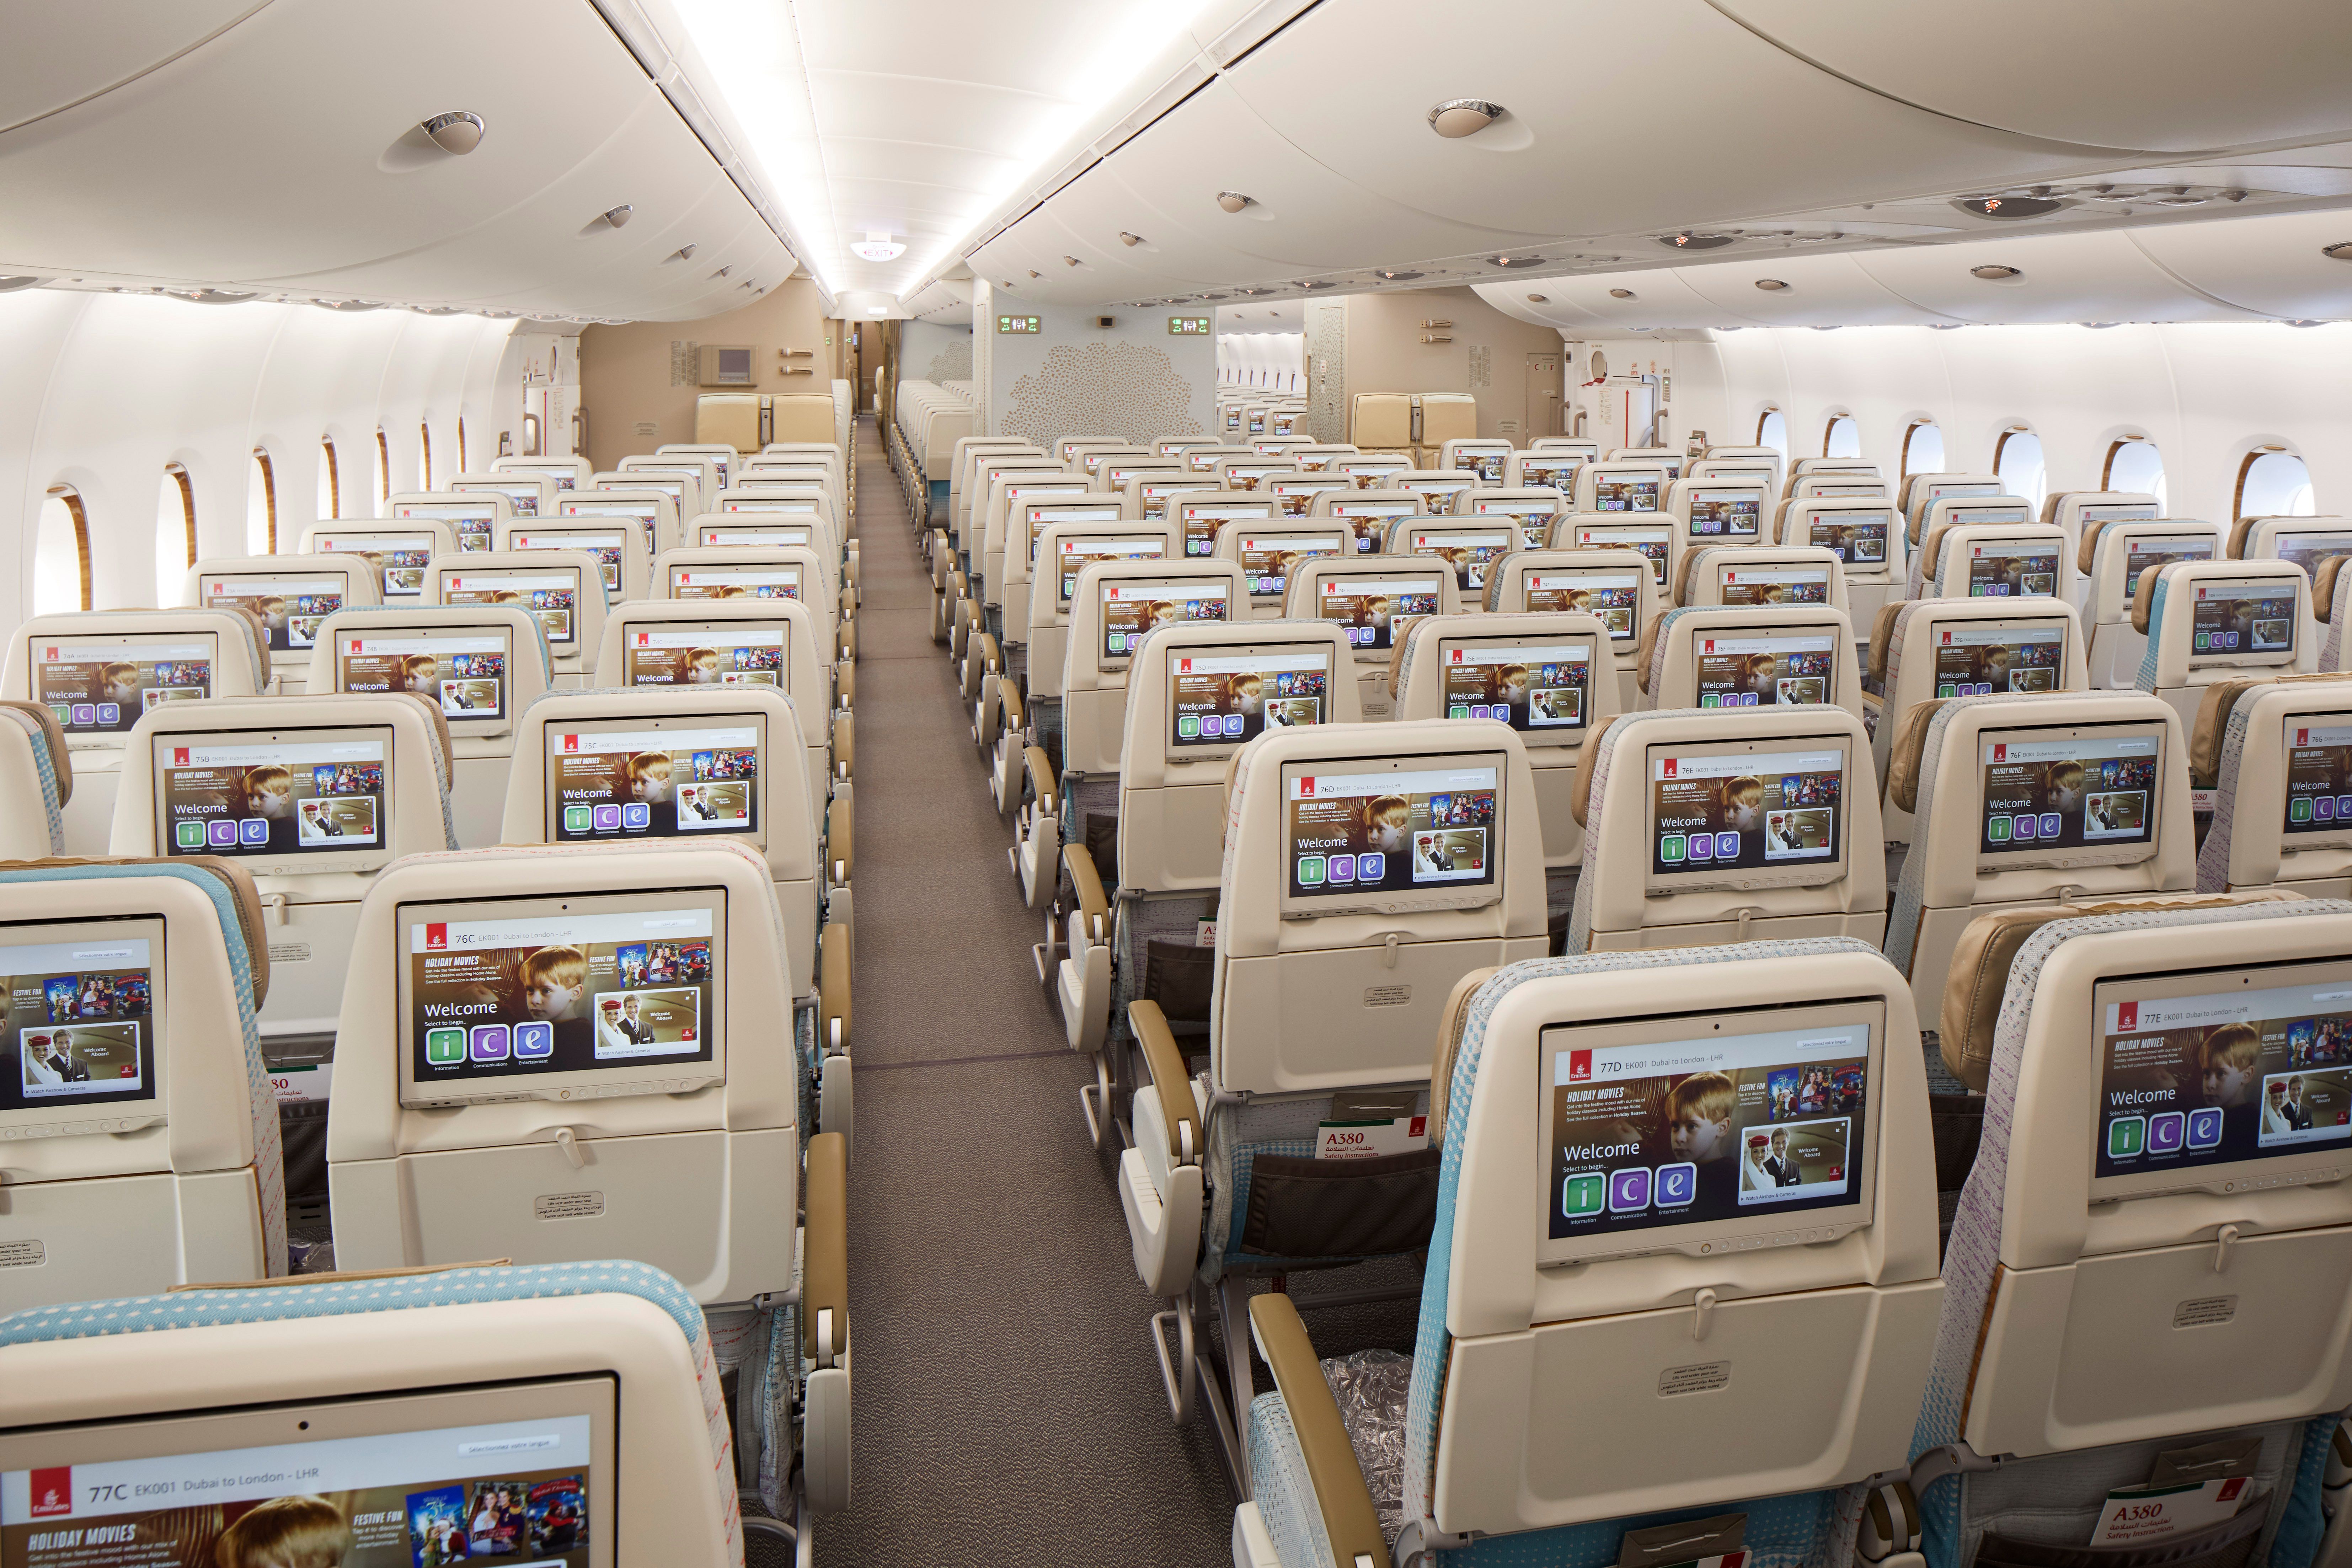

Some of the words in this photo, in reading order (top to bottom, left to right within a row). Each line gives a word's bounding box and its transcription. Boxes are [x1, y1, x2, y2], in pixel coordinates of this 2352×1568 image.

[2292, 781, 2330, 791] Welcome
[563, 789, 612, 798] Welcome
[175, 804, 227, 814] Welcome
[1989, 799, 2031, 809] Welcome
[1661, 817, 1706, 827] Welcome
[1298, 837, 1347, 849] Welcome
[455, 935, 475, 944] 76C
[425, 958, 452, 967] HOLIDAY
[454, 956, 479, 966] MOVIES
[425, 1002, 497, 1017] Welcome
[2144, 1014, 2161, 1024] 77E
[2211, 1008, 2231, 1016] London
[2115, 1039, 2140, 1051] HOLIDAY
[2141, 1037, 2164, 1049] MOVIES
[1600, 1062, 1621, 1073] 77D
[1626, 1061, 1647, 1069] EK001
[1651, 1059, 1669, 1067] Dubai
[1681, 1055, 1704, 1064] London
[272, 1079, 288, 1089] 80
[1739, 1083, 1756, 1091] FESTIVE
[1567, 1090, 1596, 1102] HOLIDAY
[1597, 1087, 1624, 1099] MOVIES
[2110, 1088, 2176, 1106] Welcome
[1327, 1133, 1364, 1144] A380
[1563, 1142, 1640, 1161] Welcome
[1581, 1182, 1587, 1207] i
[1666, 1172, 1683, 1197] e
[89, 1484, 127, 1503] 77C
[135, 1482, 175, 1496] EK001
[184, 1477, 218, 1491] Dubai
[223, 1478, 235, 1487] to
[240, 1471, 283, 1486] London
[296, 1467, 319, 1479] LHR
[33, 1503, 69, 1513] Emirates
[2113, 1503, 2163, 1521] A380
[354, 1512, 385, 1526] FESTIVE
[387, 1510, 403, 1522] FUN
[2133, 1525, 2174, 1537] Instructions
[28, 1530, 83, 1551] HOLIDAY
[86, 1524, 136, 1545] MOVIES
